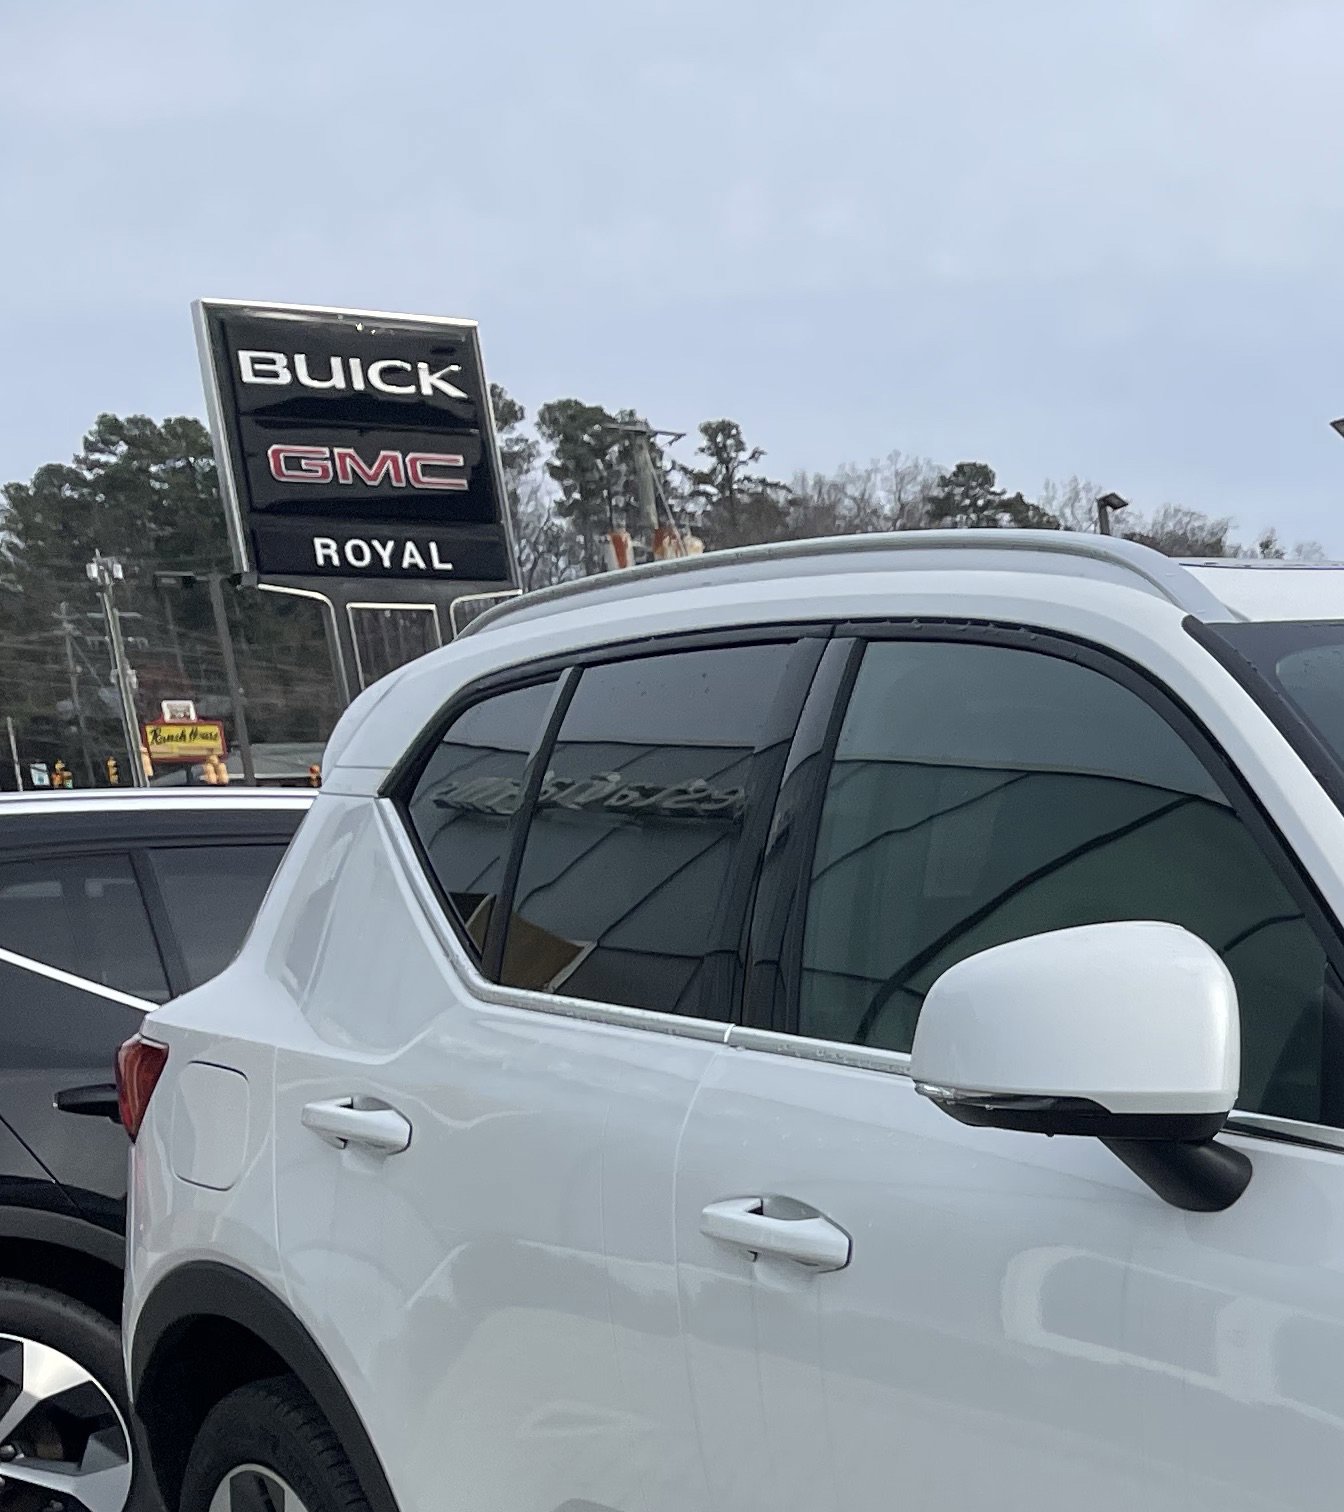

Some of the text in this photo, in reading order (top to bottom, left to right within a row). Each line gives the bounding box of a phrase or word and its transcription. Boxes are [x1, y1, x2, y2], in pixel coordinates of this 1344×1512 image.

[237, 350, 468, 399] BUICK
[267, 444, 469, 491] GMC
[313, 537, 453, 570] ROYAL
